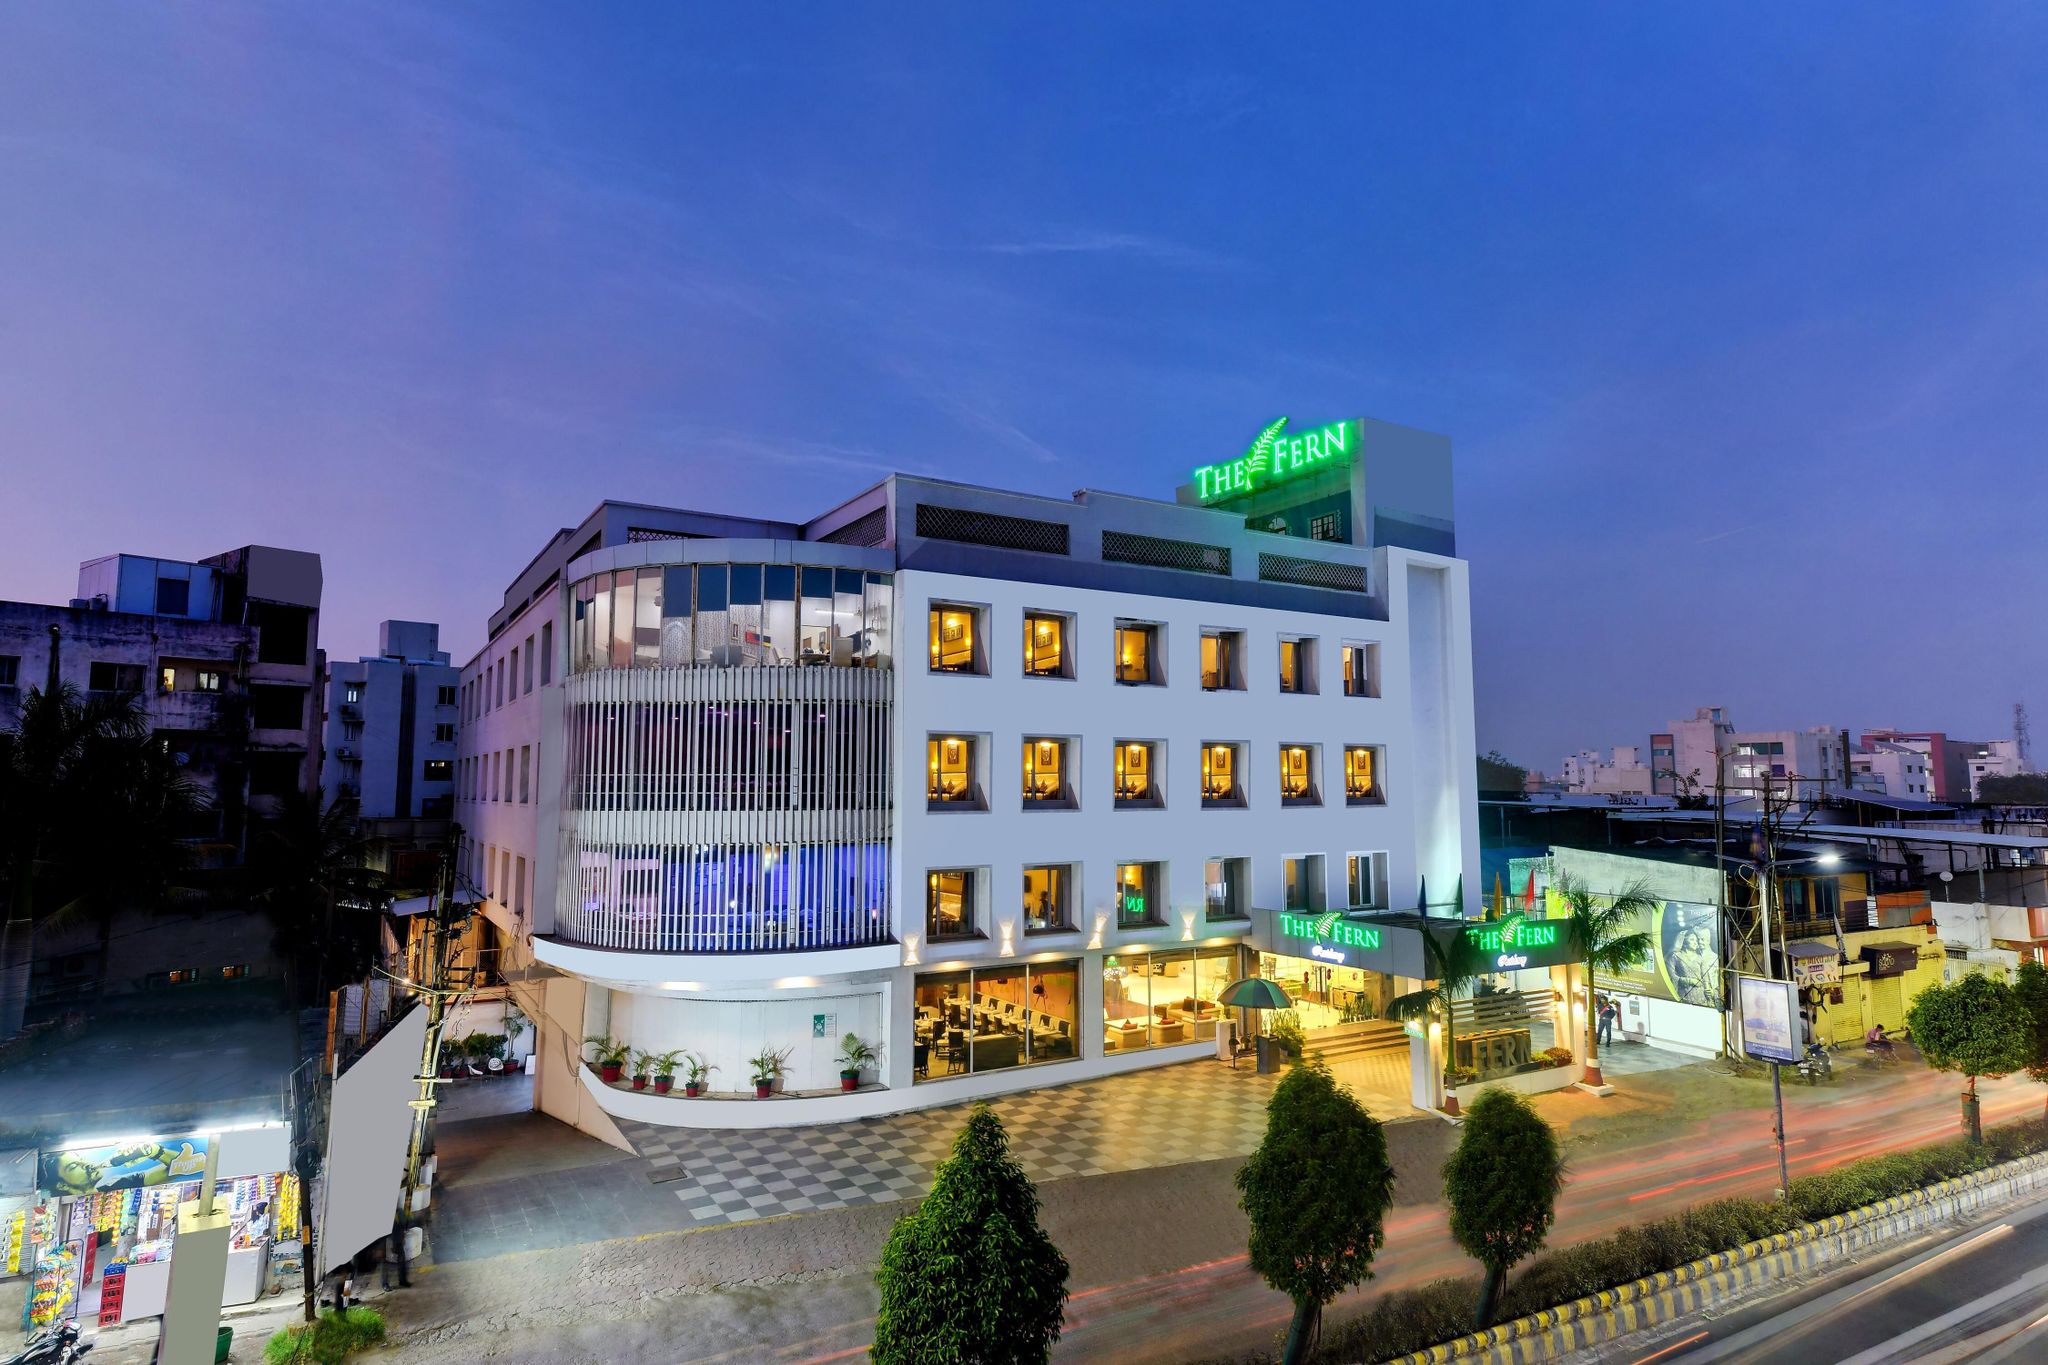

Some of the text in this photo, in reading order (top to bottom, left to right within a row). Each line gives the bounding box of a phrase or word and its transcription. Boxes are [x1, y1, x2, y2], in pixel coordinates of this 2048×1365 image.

[1194, 421, 1346, 499] THE FERN
[1280, 913, 1380, 949] THE FERN
[1465, 925, 1555, 951] THE FERN
